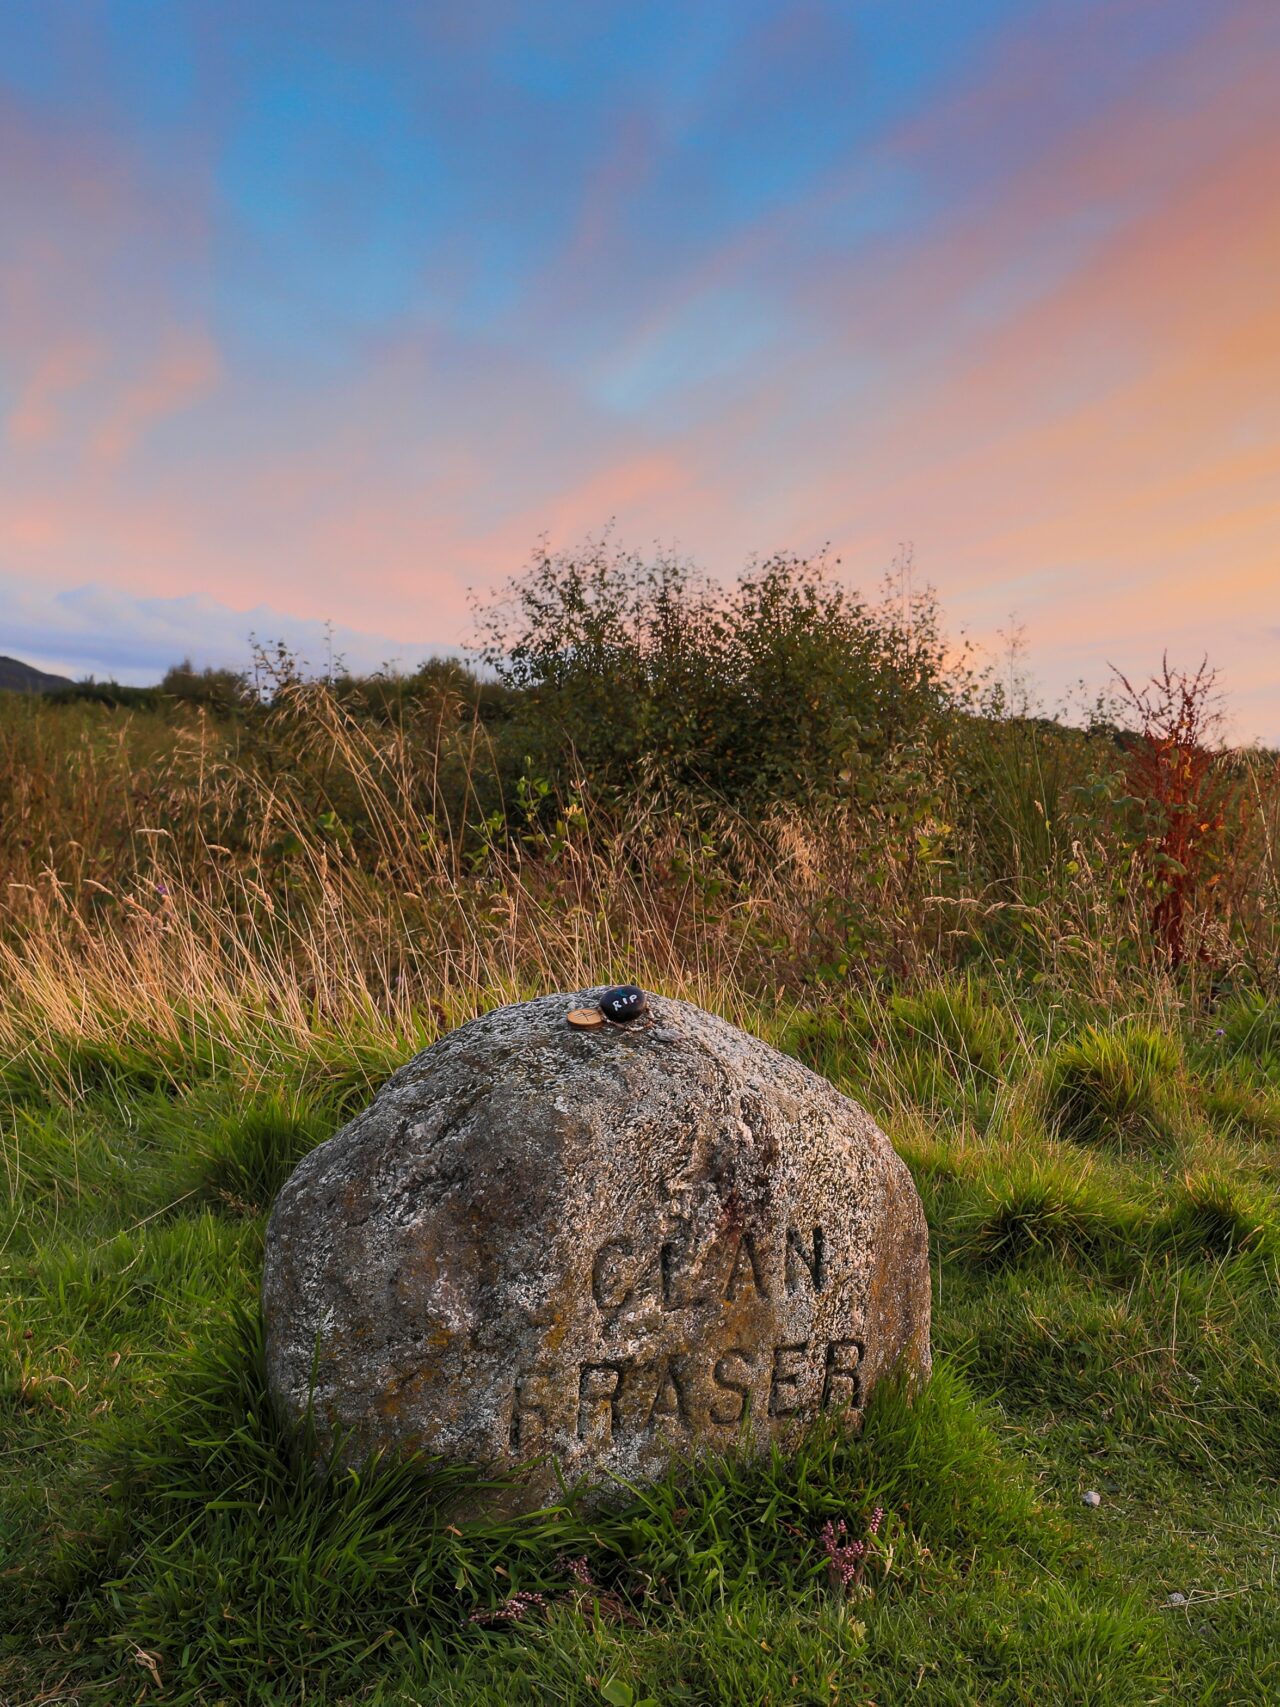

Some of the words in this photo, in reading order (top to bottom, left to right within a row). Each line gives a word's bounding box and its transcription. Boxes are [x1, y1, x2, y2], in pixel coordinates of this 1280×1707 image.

[612, 994, 638, 1012] RIP
[592, 1226, 827, 1309] CLAN
[508, 1338, 866, 1450] FRASER
